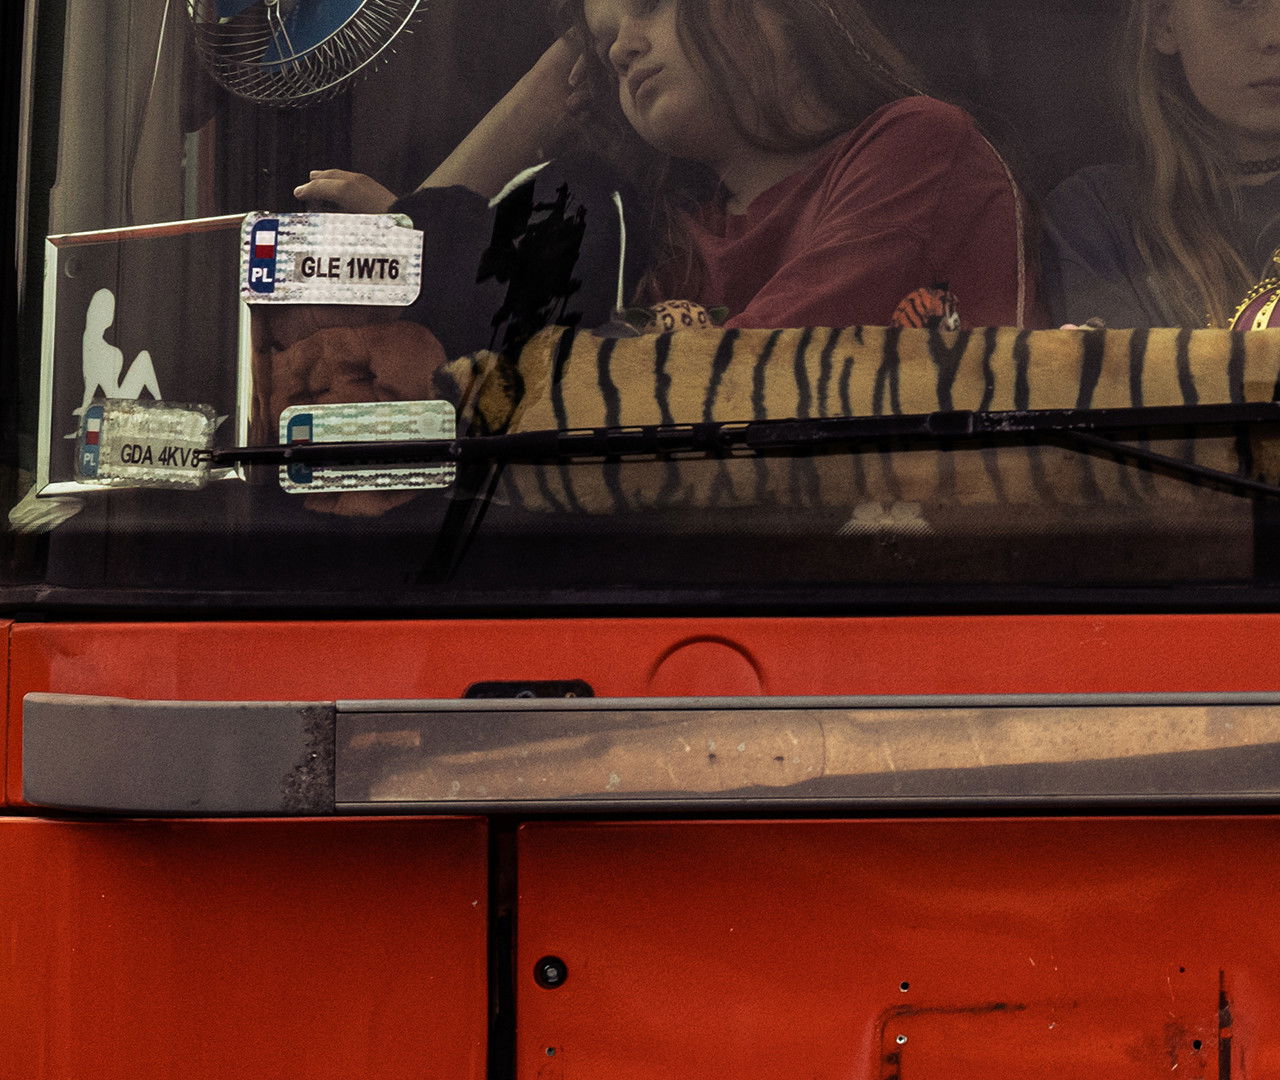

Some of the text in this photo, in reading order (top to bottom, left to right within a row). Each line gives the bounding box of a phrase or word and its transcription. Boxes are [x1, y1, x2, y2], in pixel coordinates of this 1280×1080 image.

[251, 267, 273, 283] PL
[301, 256, 399, 280] GLE 1WT6
[83, 452, 96, 466] PL
[121, 443, 201, 468] GDA 4KV8
